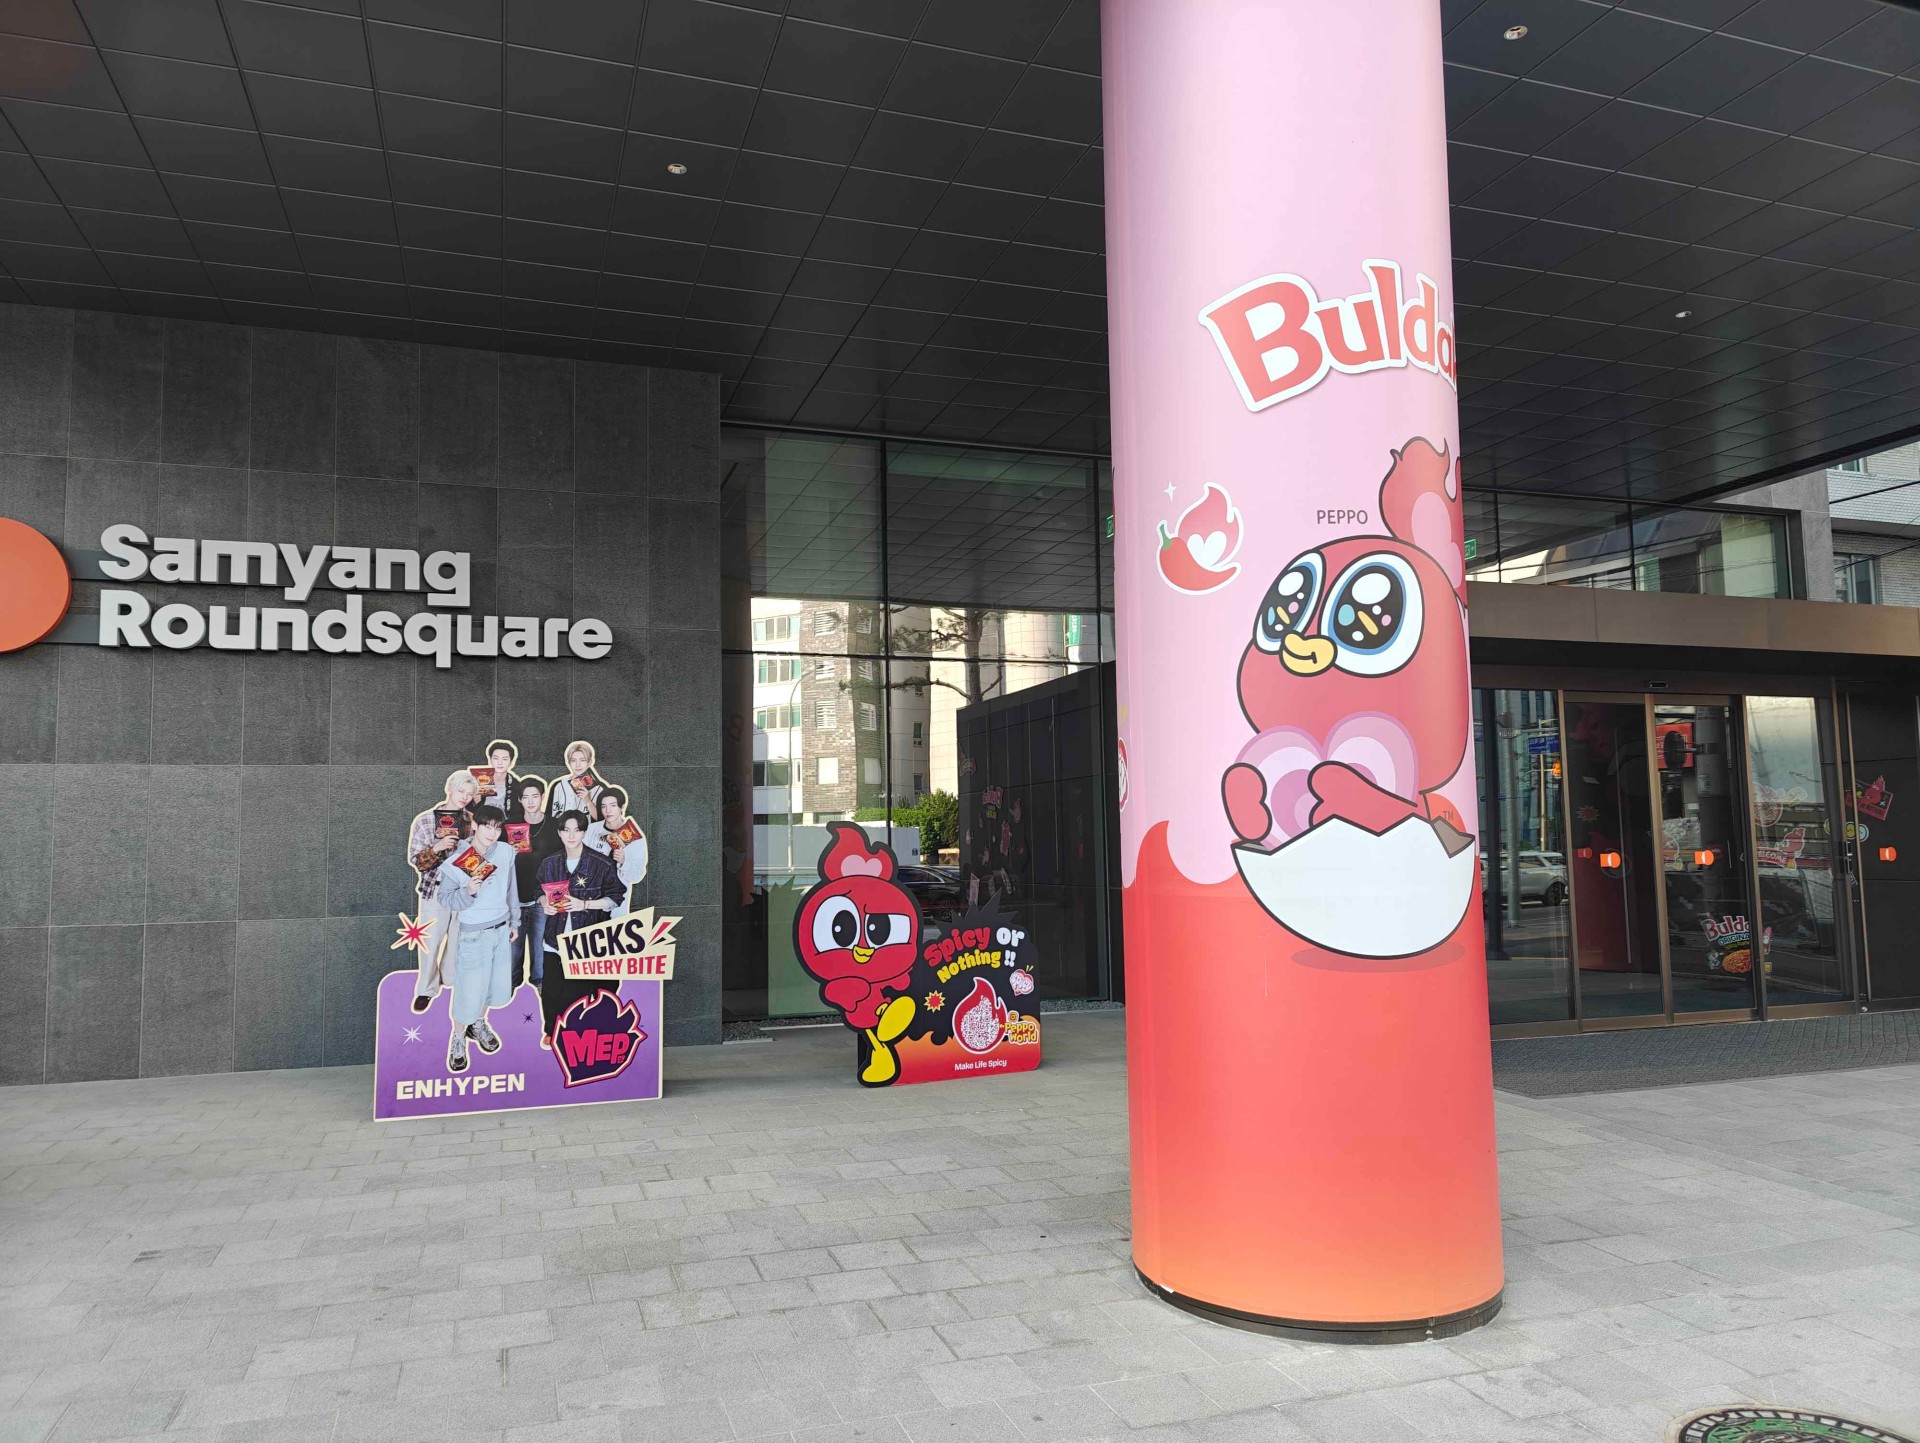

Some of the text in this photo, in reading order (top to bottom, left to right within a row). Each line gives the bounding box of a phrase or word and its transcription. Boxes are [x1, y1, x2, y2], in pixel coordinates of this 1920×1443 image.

[1203, 263, 1457, 405] Bulda
[1316, 509, 1368, 525] PEPPO
[98, 524, 471, 606] Samyang
[98, 589, 614, 668] Roundsquare
[1757, 851, 1787, 864] ELCOME
[562, 919, 646, 960] KICKS
[923, 927, 991, 967] Spicy
[569, 955, 667, 975] IN EVERY BITE
[936, 949, 1017, 983] Nothing !!
[1005, 1022, 1036, 1034] Peppo
[562, 1029, 631, 1068] MEP
[954, 1059, 1008, 1071] Make Life Spicy
[396, 1073, 525, 1100] ENHYPEN
